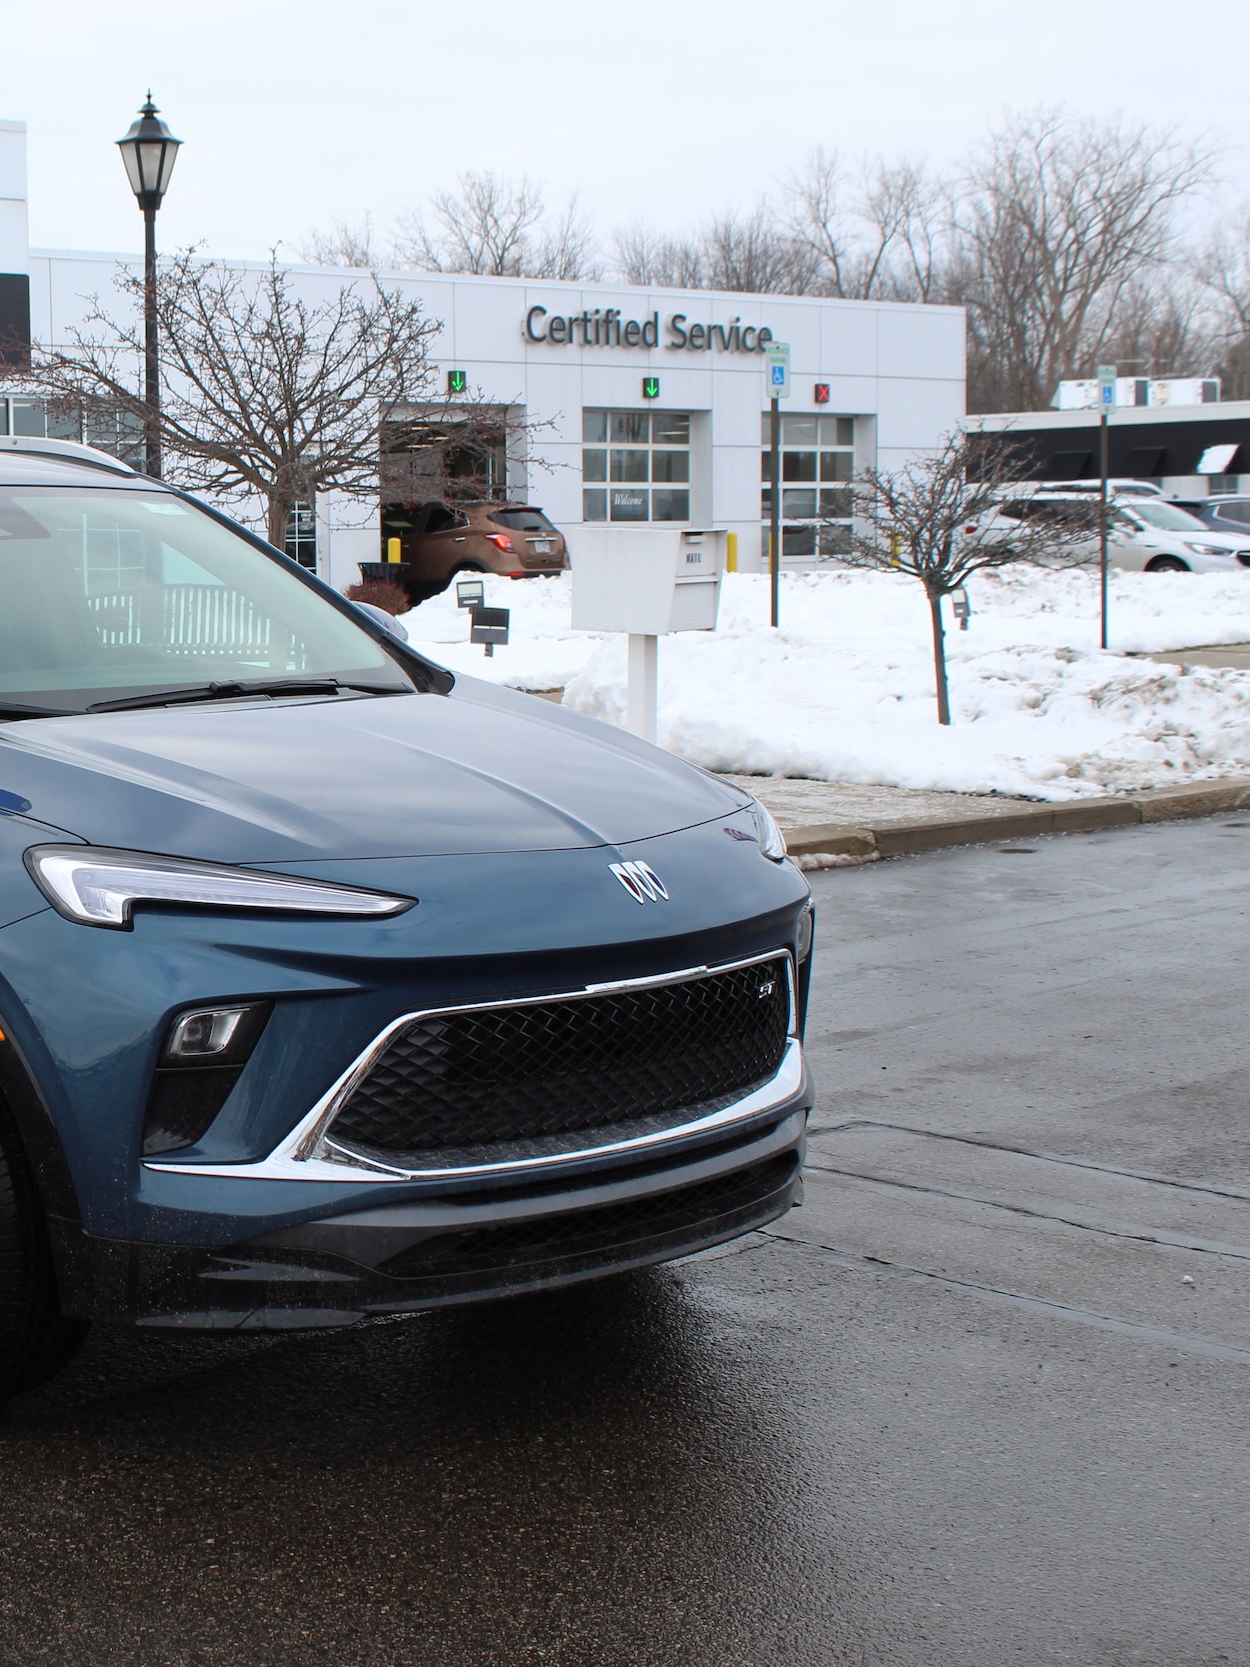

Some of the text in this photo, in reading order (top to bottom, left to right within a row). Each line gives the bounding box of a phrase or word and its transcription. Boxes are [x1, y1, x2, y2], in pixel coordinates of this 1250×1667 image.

[523, 304, 773, 352] Certified Service
[614, 493, 643, 505] Welcome
[686, 553, 702, 563] MAIL
